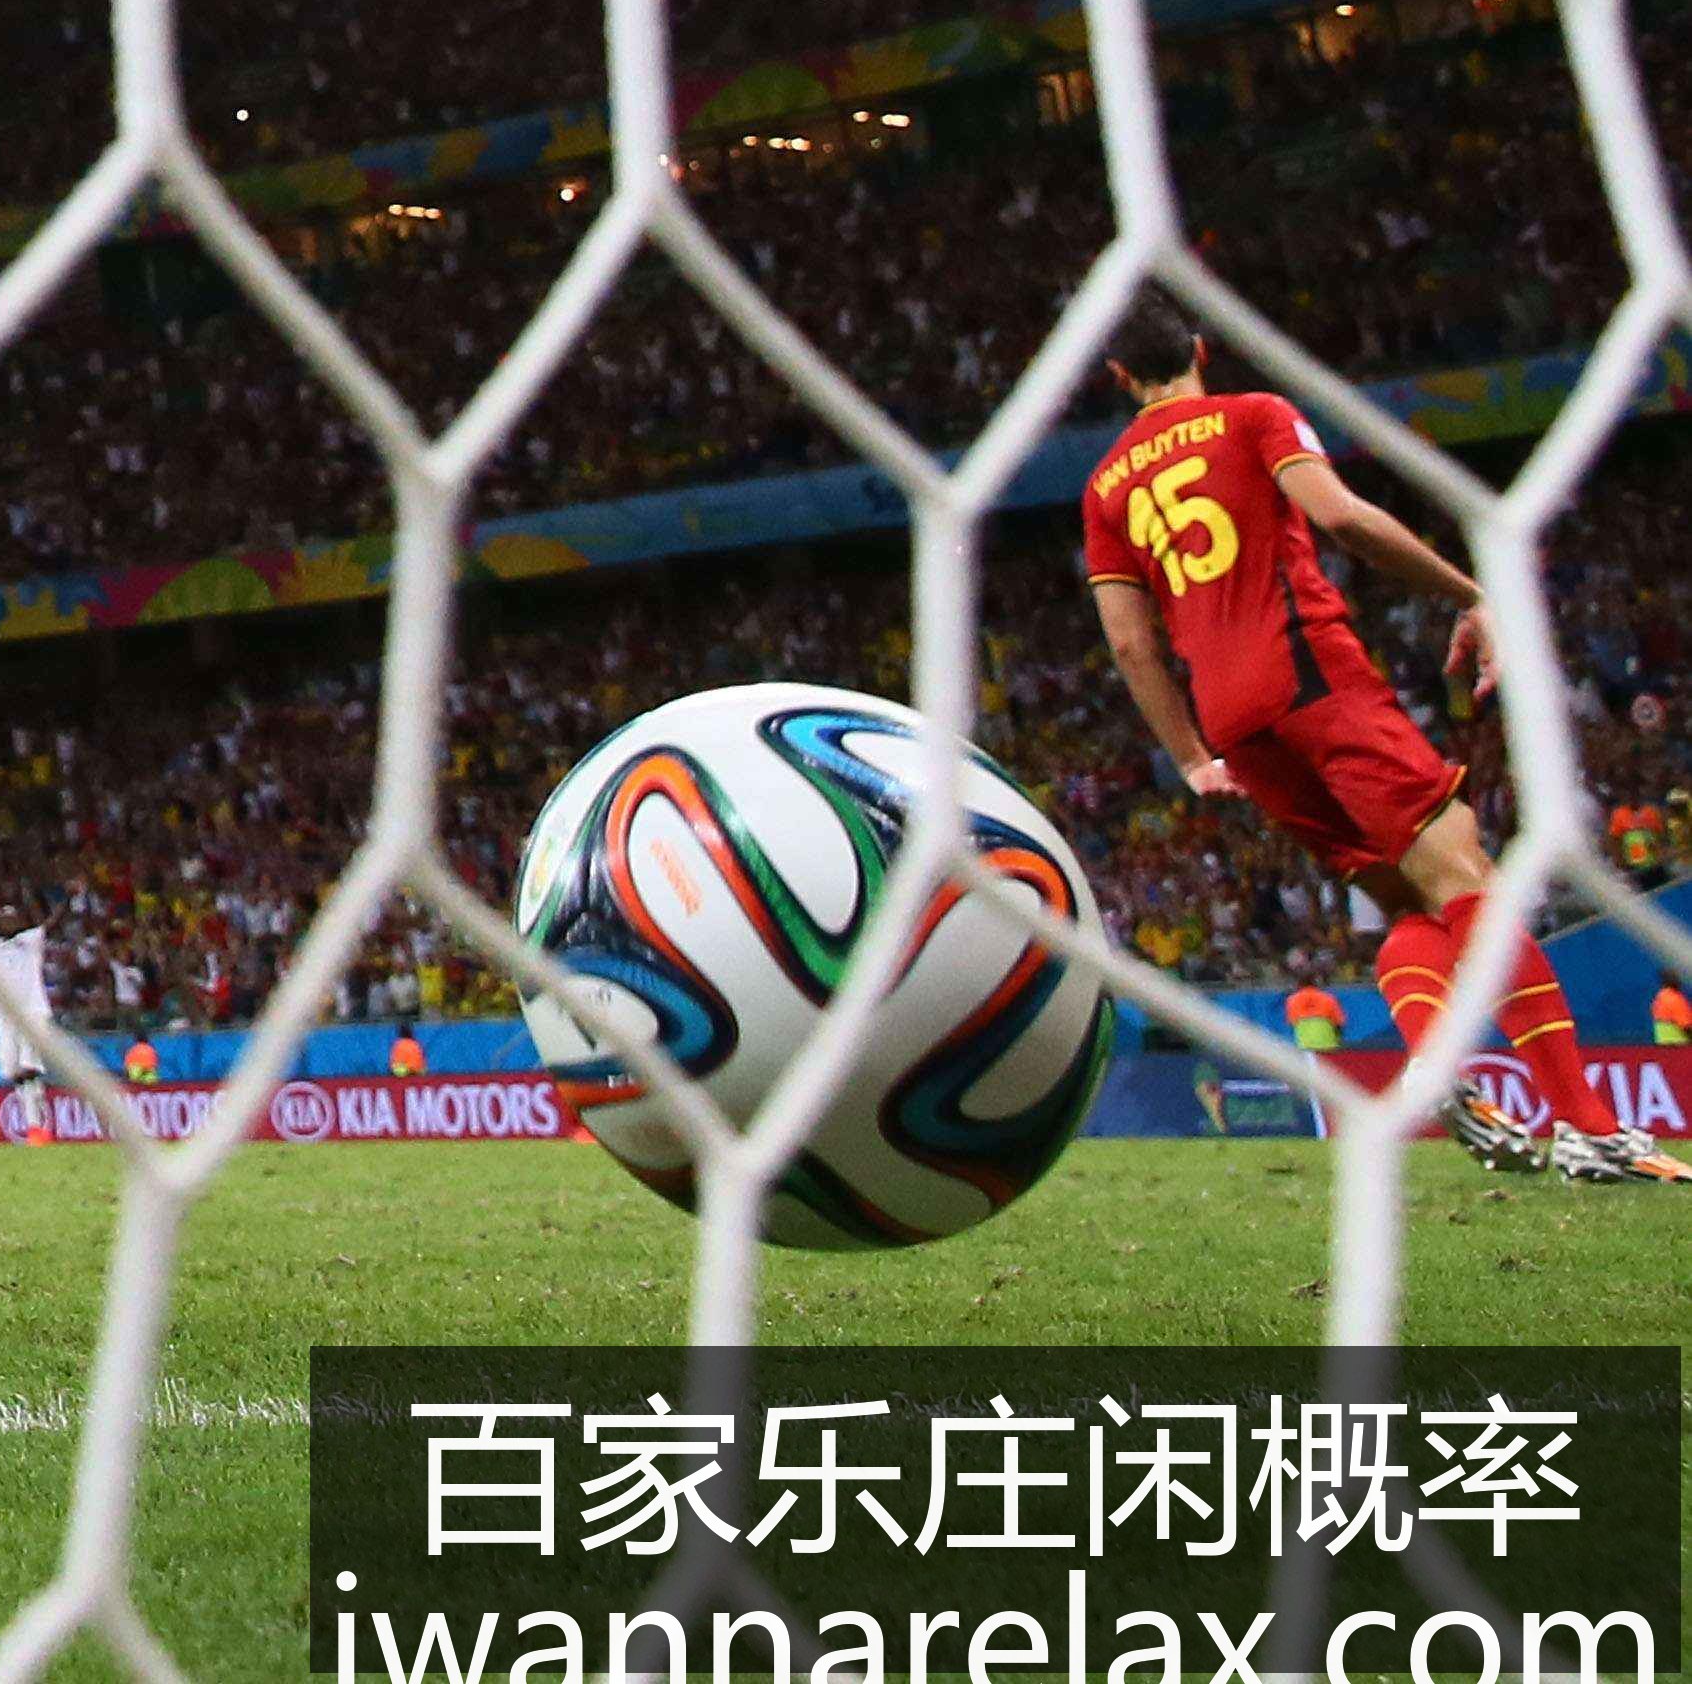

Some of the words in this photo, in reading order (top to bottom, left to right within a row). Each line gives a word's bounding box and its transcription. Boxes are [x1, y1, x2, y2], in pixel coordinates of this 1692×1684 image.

[1128, 411, 1226, 473] BUYTEN
[1127, 455, 1240, 598] 15
[336, 1086, 399, 1137] KIA
[404, 1082, 560, 1138] MOTORS
